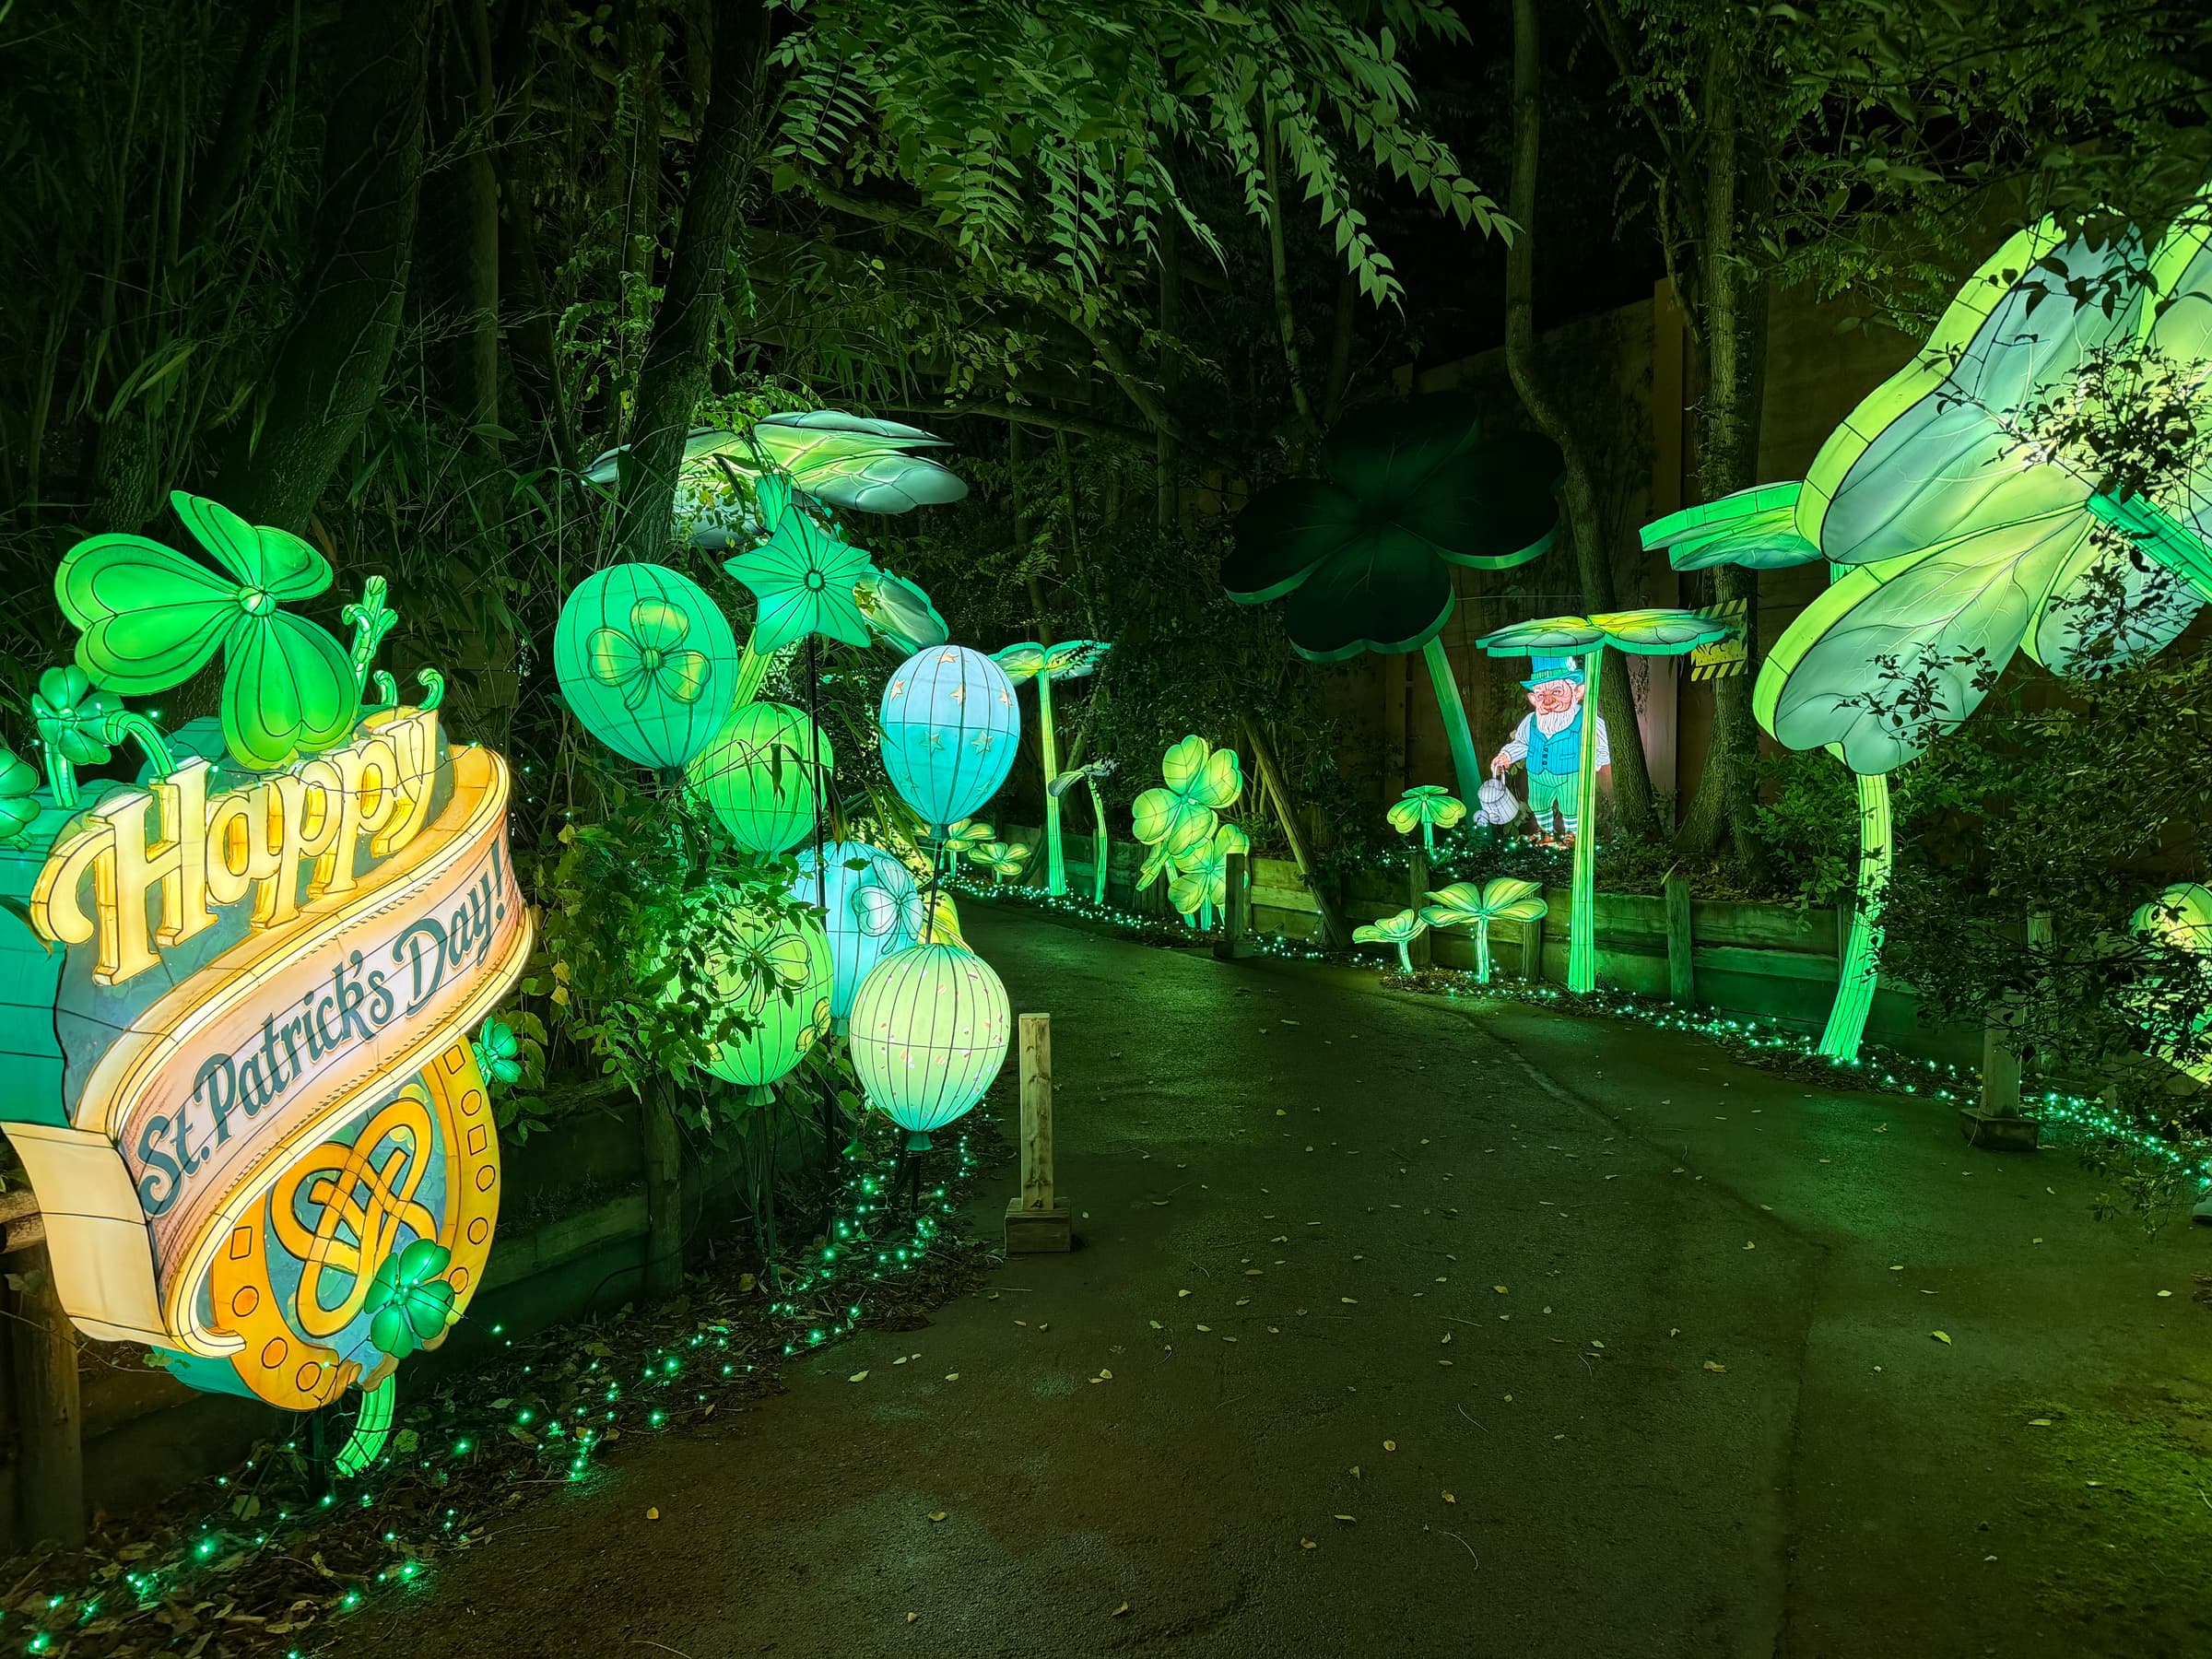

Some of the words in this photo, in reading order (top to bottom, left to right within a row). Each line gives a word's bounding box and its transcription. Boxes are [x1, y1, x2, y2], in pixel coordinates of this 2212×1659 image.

[30, 708, 439, 986] Happy
[137, 1112, 212, 1217] St.
[192, 949, 395, 1148] Patrick's
[391, 839, 507, 1018] Day!
